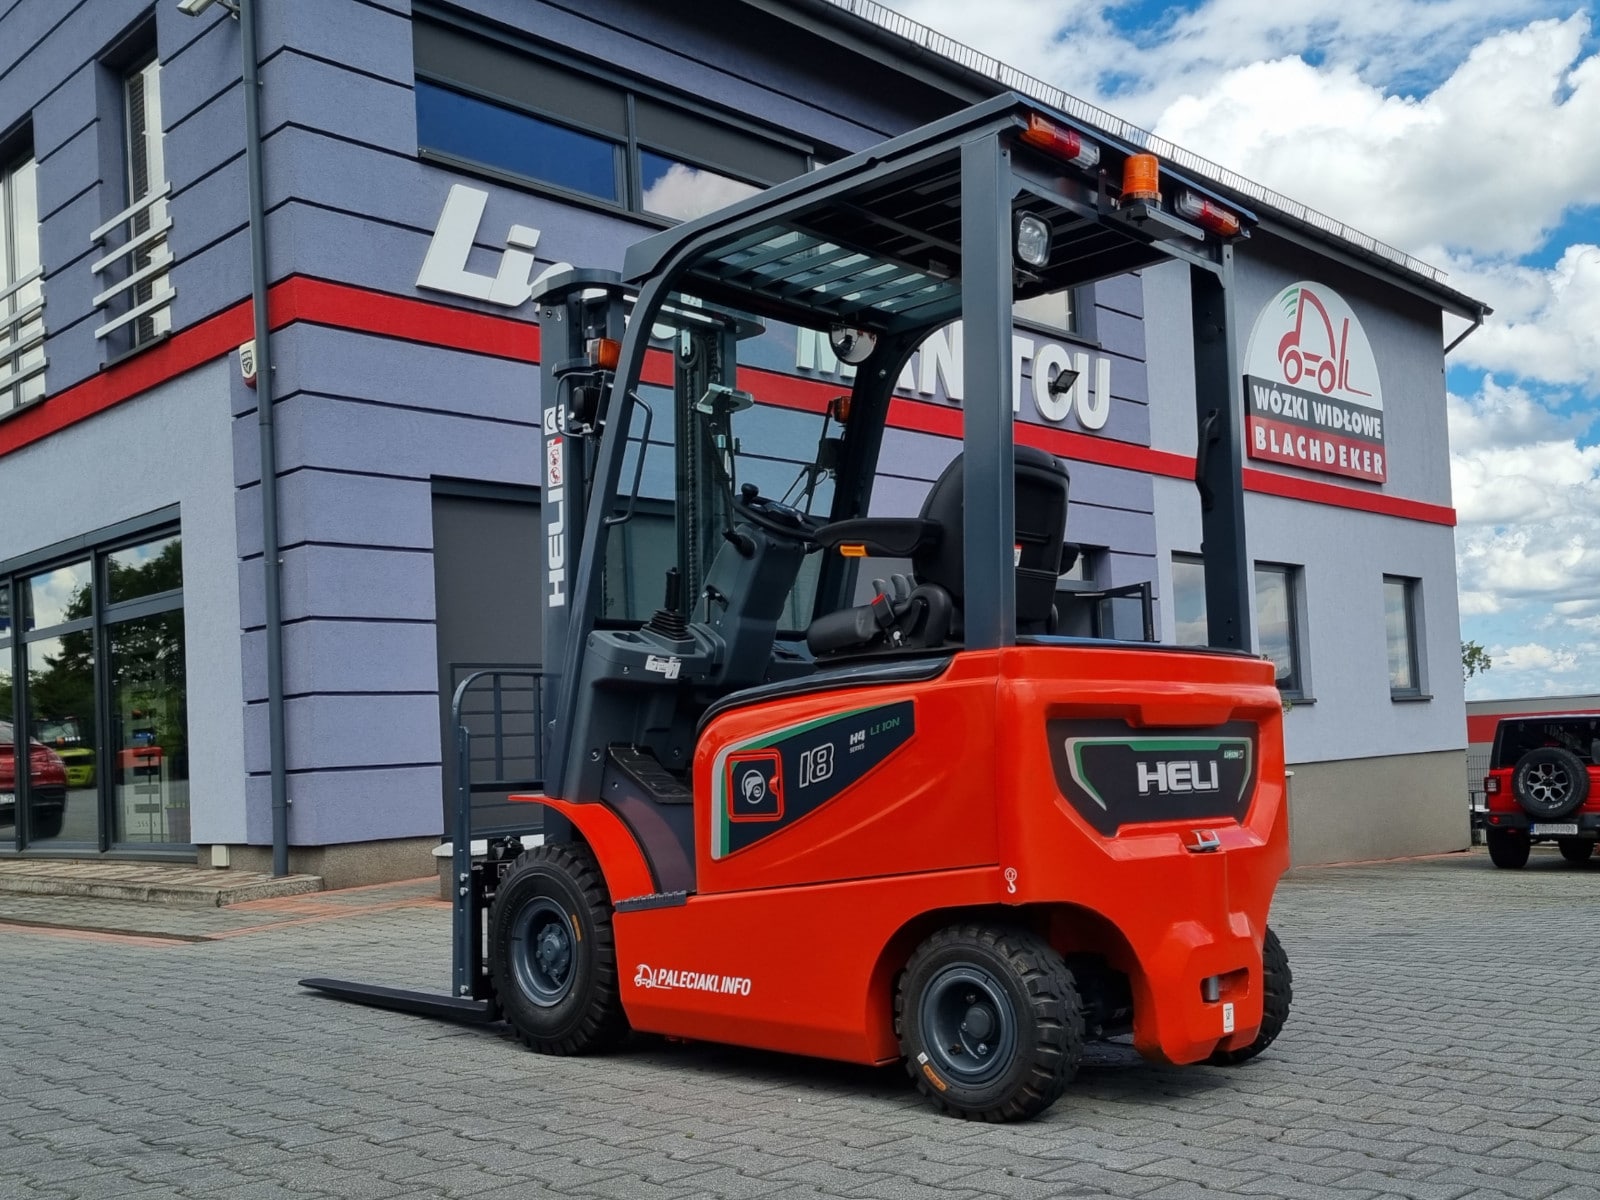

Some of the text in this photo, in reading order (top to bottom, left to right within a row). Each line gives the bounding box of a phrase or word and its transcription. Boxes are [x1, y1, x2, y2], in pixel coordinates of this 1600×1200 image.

[1253, 383, 1382, 439] WÓZKI WIDŁOWE
[1255, 426, 1383, 475] BLACHDEKER
[548, 487, 565, 607] HELI
[850, 730, 866, 745] H4
[799, 743, 834, 788] 18
[1137, 761, 1219, 794] HELI
[658, 968, 752, 996] PALECIAKI.INFO
